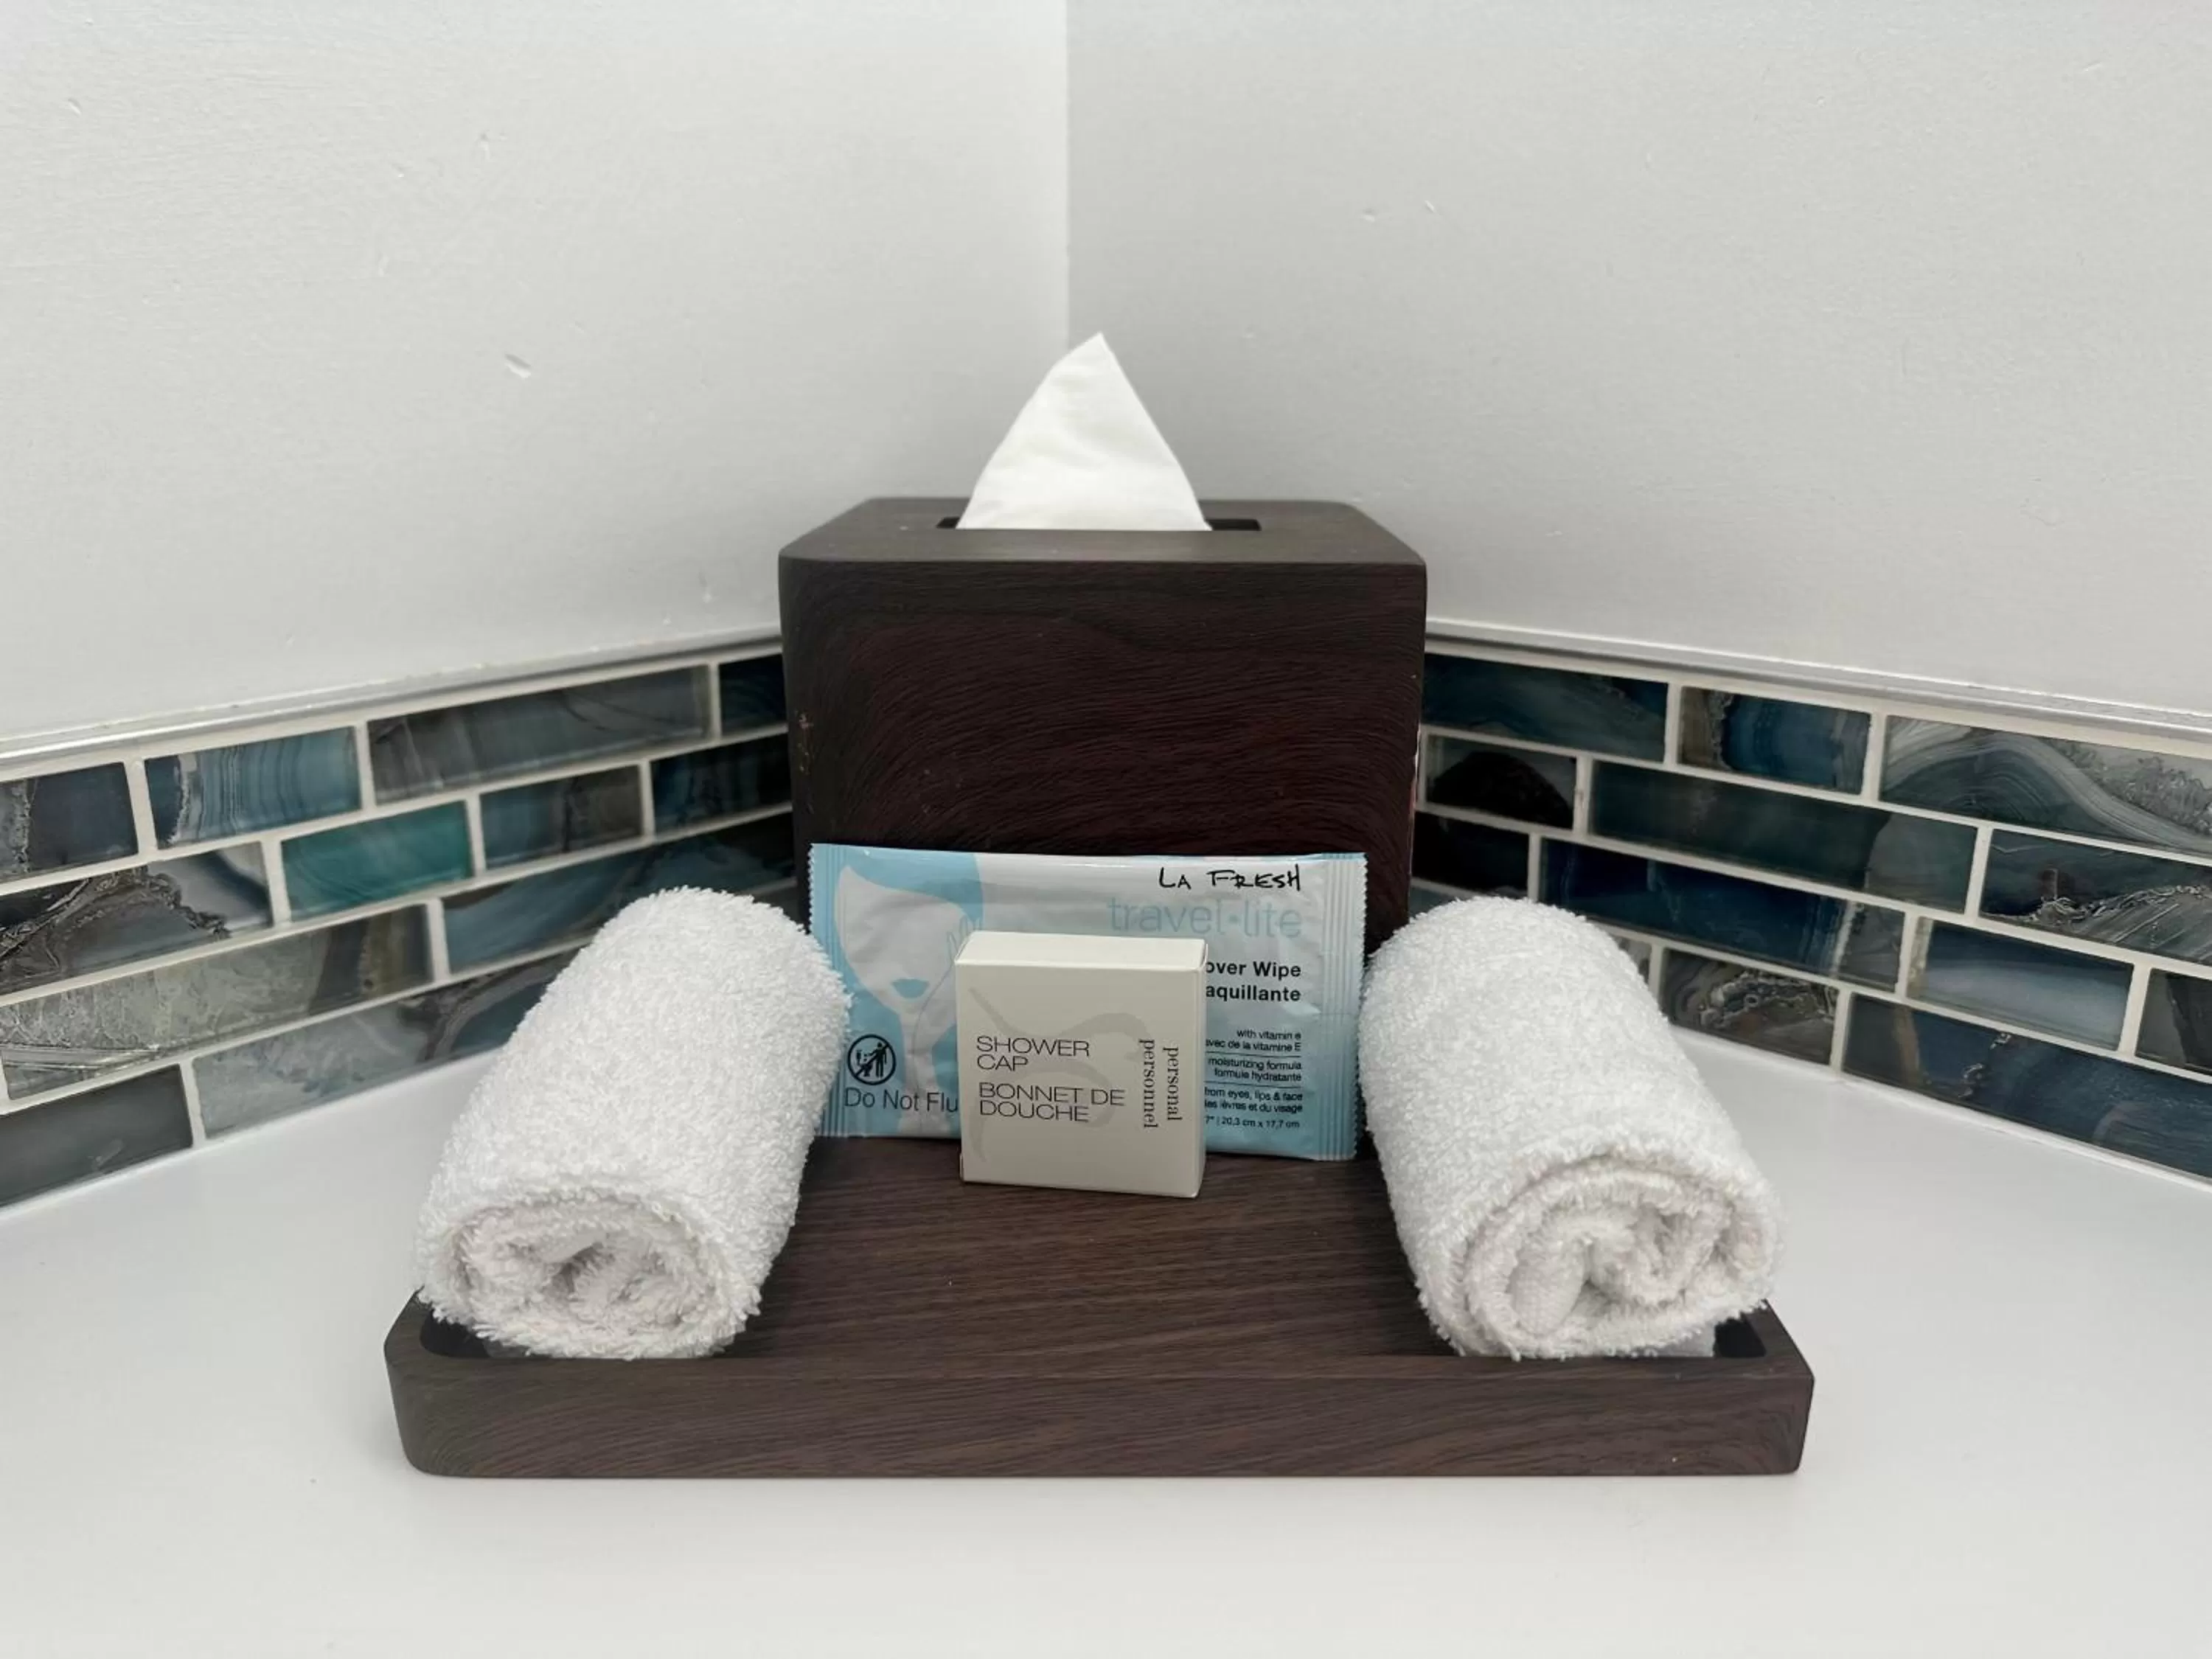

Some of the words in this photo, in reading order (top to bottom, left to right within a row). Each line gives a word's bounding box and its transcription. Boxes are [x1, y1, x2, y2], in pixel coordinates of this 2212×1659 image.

[1158, 867, 1192, 890] LA
[1206, 863, 1301, 891] FRESH
[1253, 961, 1301, 981] Wipe
[1237, 1030, 1256, 1039] with
[1259, 1031, 1293, 1040] vitamin
[976, 1035, 1090, 1057] SHOWER
[1228, 1040, 1240, 1048] de
[1253, 1042, 1293, 1052] vitamine
[1295, 1042, 1301, 1051] E
[977, 1054, 1029, 1071] CAP
[1208, 1057, 1265, 1071] moisturizing
[1267, 1060, 1301, 1070] formula
[1138, 1038, 1159, 1129] personnel
[1163, 1046, 1183, 1121] personal
[1251, 1071, 1301, 1082] hydratante
[845, 1087, 876, 1108] Do
[883, 1089, 919, 1111] Not
[978, 1082, 1084, 1104] BONNET
[1091, 1088, 1126, 1107] DE
[1282, 1092, 1303, 1101] face
[979, 1100, 1090, 1122] DOUCHE
[1259, 1103, 1272, 1113] du
[1242, 1119, 1256, 1127] cm
